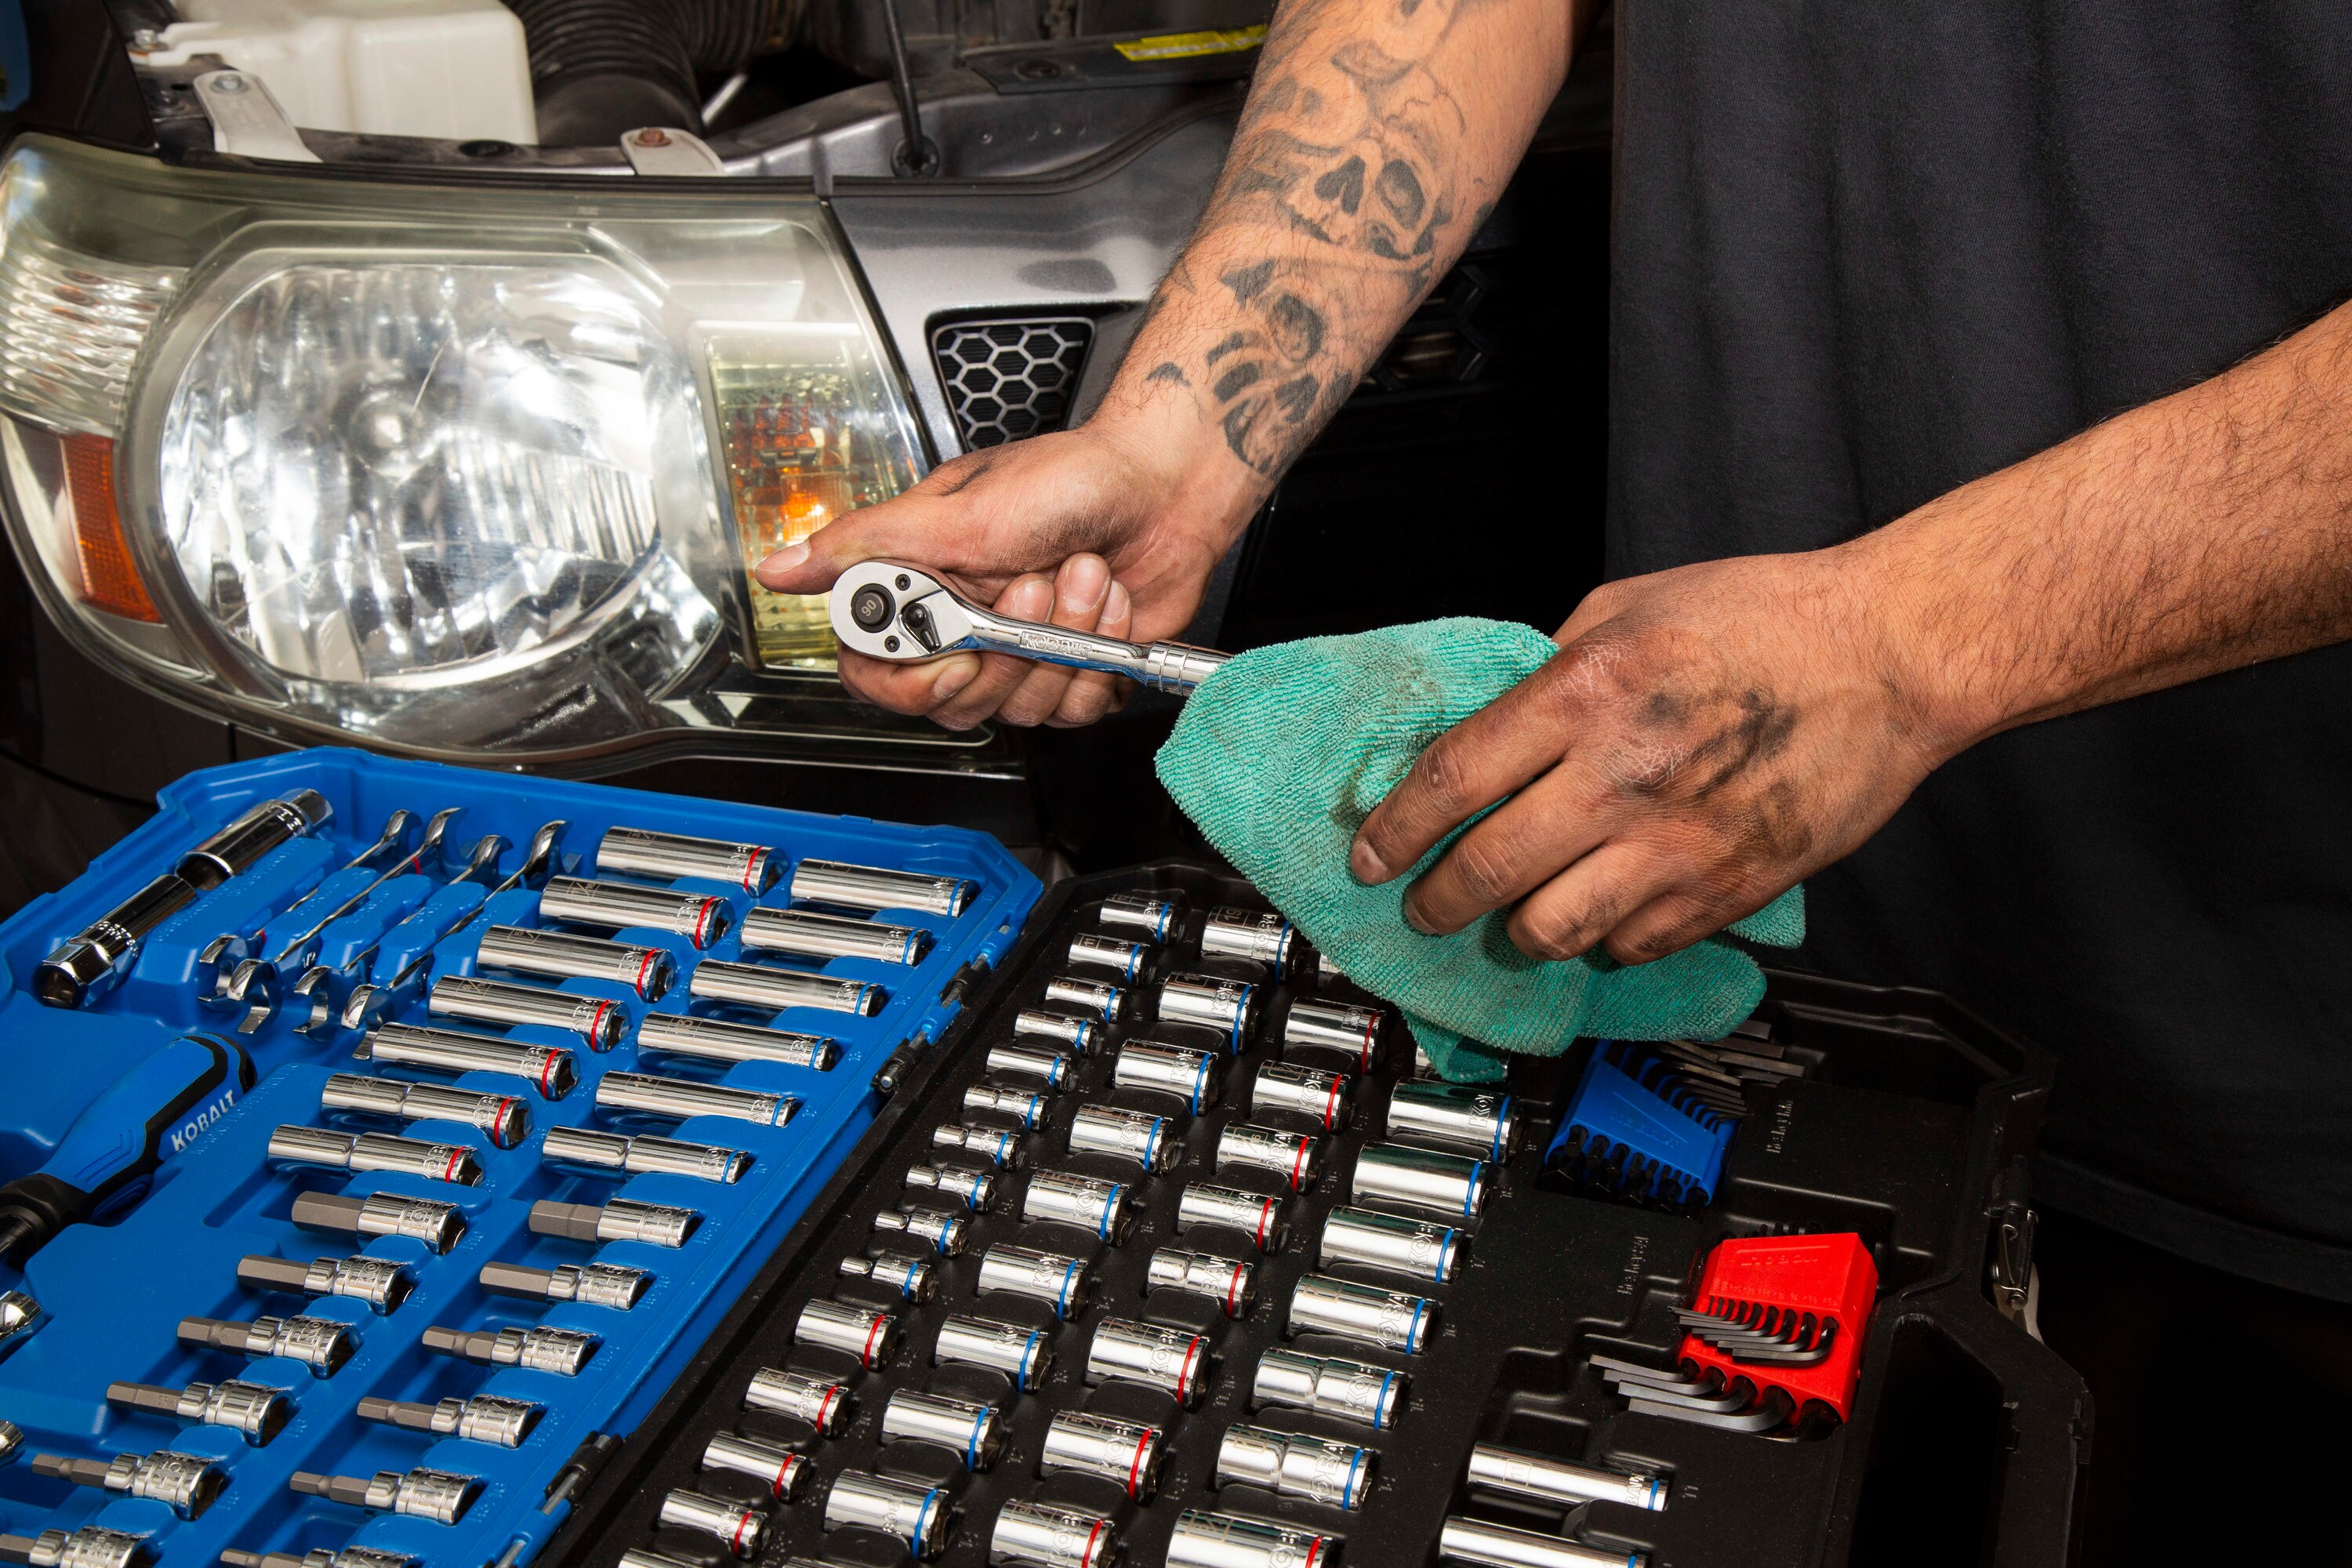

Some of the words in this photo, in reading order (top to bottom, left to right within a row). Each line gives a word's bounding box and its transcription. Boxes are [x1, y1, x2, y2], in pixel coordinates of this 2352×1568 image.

[861, 599, 877, 617] 90
[1020, 631, 1091, 660] KOBALT
[1224, 909, 1243, 923] 19
[1083, 938, 1096, 946] 11
[170, 1089, 237, 1152] KOBALT
